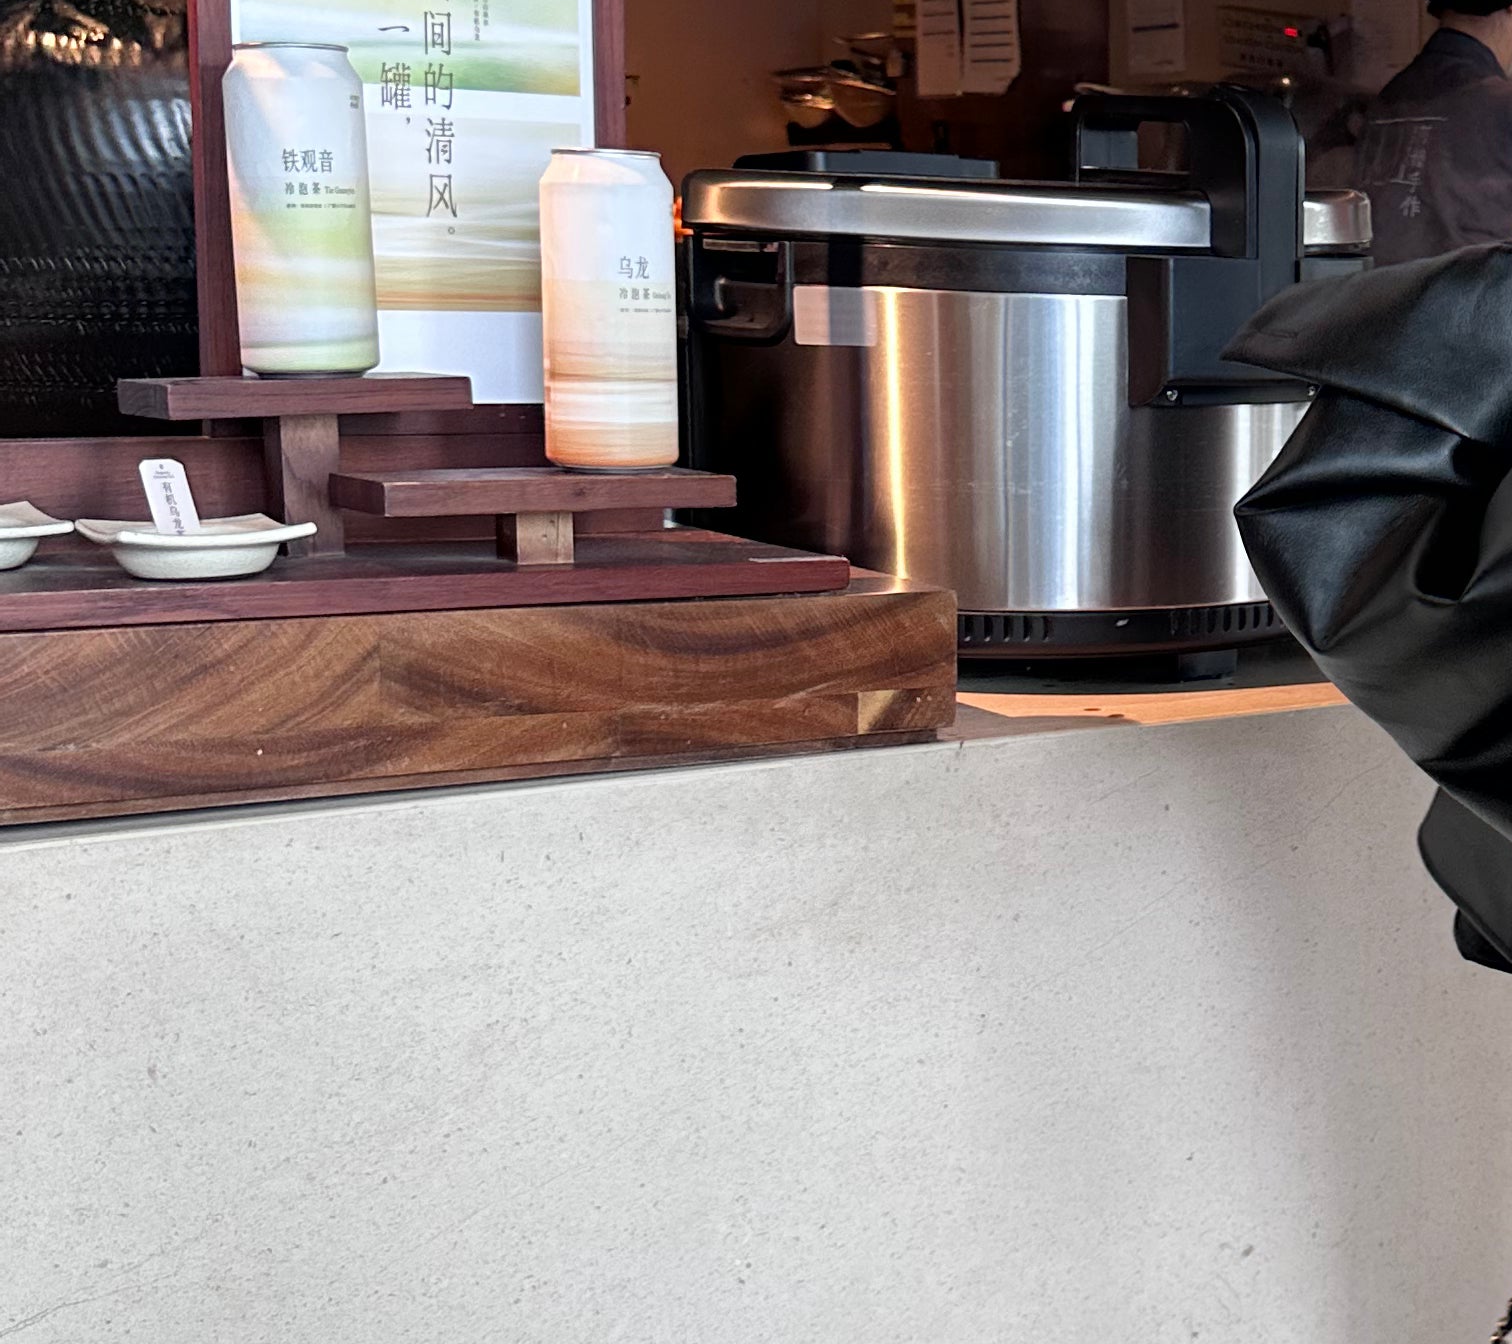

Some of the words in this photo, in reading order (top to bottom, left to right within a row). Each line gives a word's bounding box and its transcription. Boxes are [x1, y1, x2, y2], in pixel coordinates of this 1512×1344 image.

[281, 148, 334, 173] 铁观音
[617, 255, 650, 280] 乌龙
